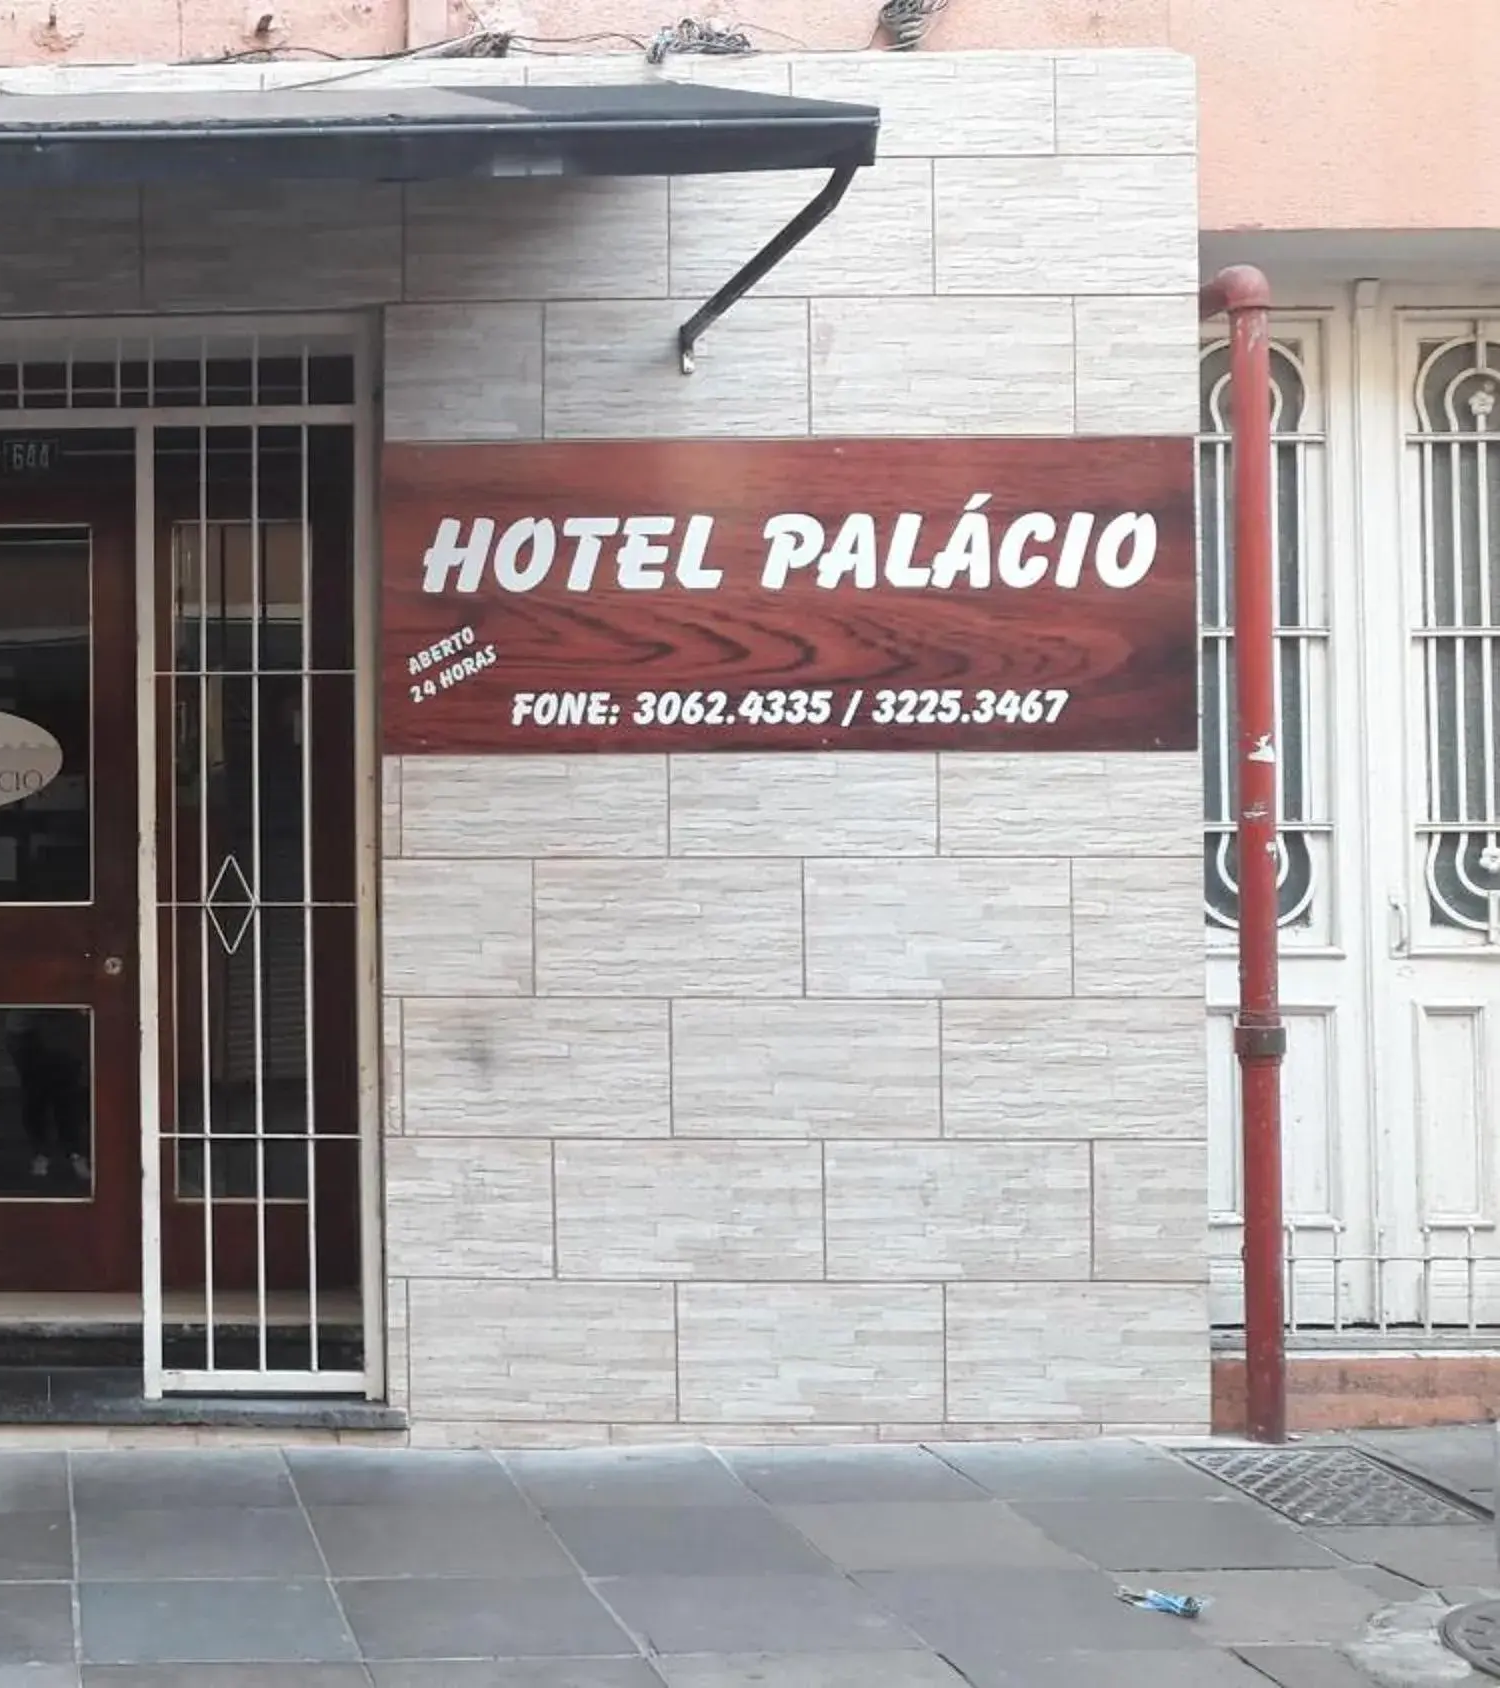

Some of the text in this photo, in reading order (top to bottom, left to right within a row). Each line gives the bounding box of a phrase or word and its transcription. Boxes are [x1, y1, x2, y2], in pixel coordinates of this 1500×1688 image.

[422, 492, 1157, 593] HOTEL PALÁCIO
[408, 626, 475, 675] ABERTO
[409, 644, 497, 703] 24 HORAS
[511, 688, 1069, 728] FONE: 3062.4335 / 3225.3467
